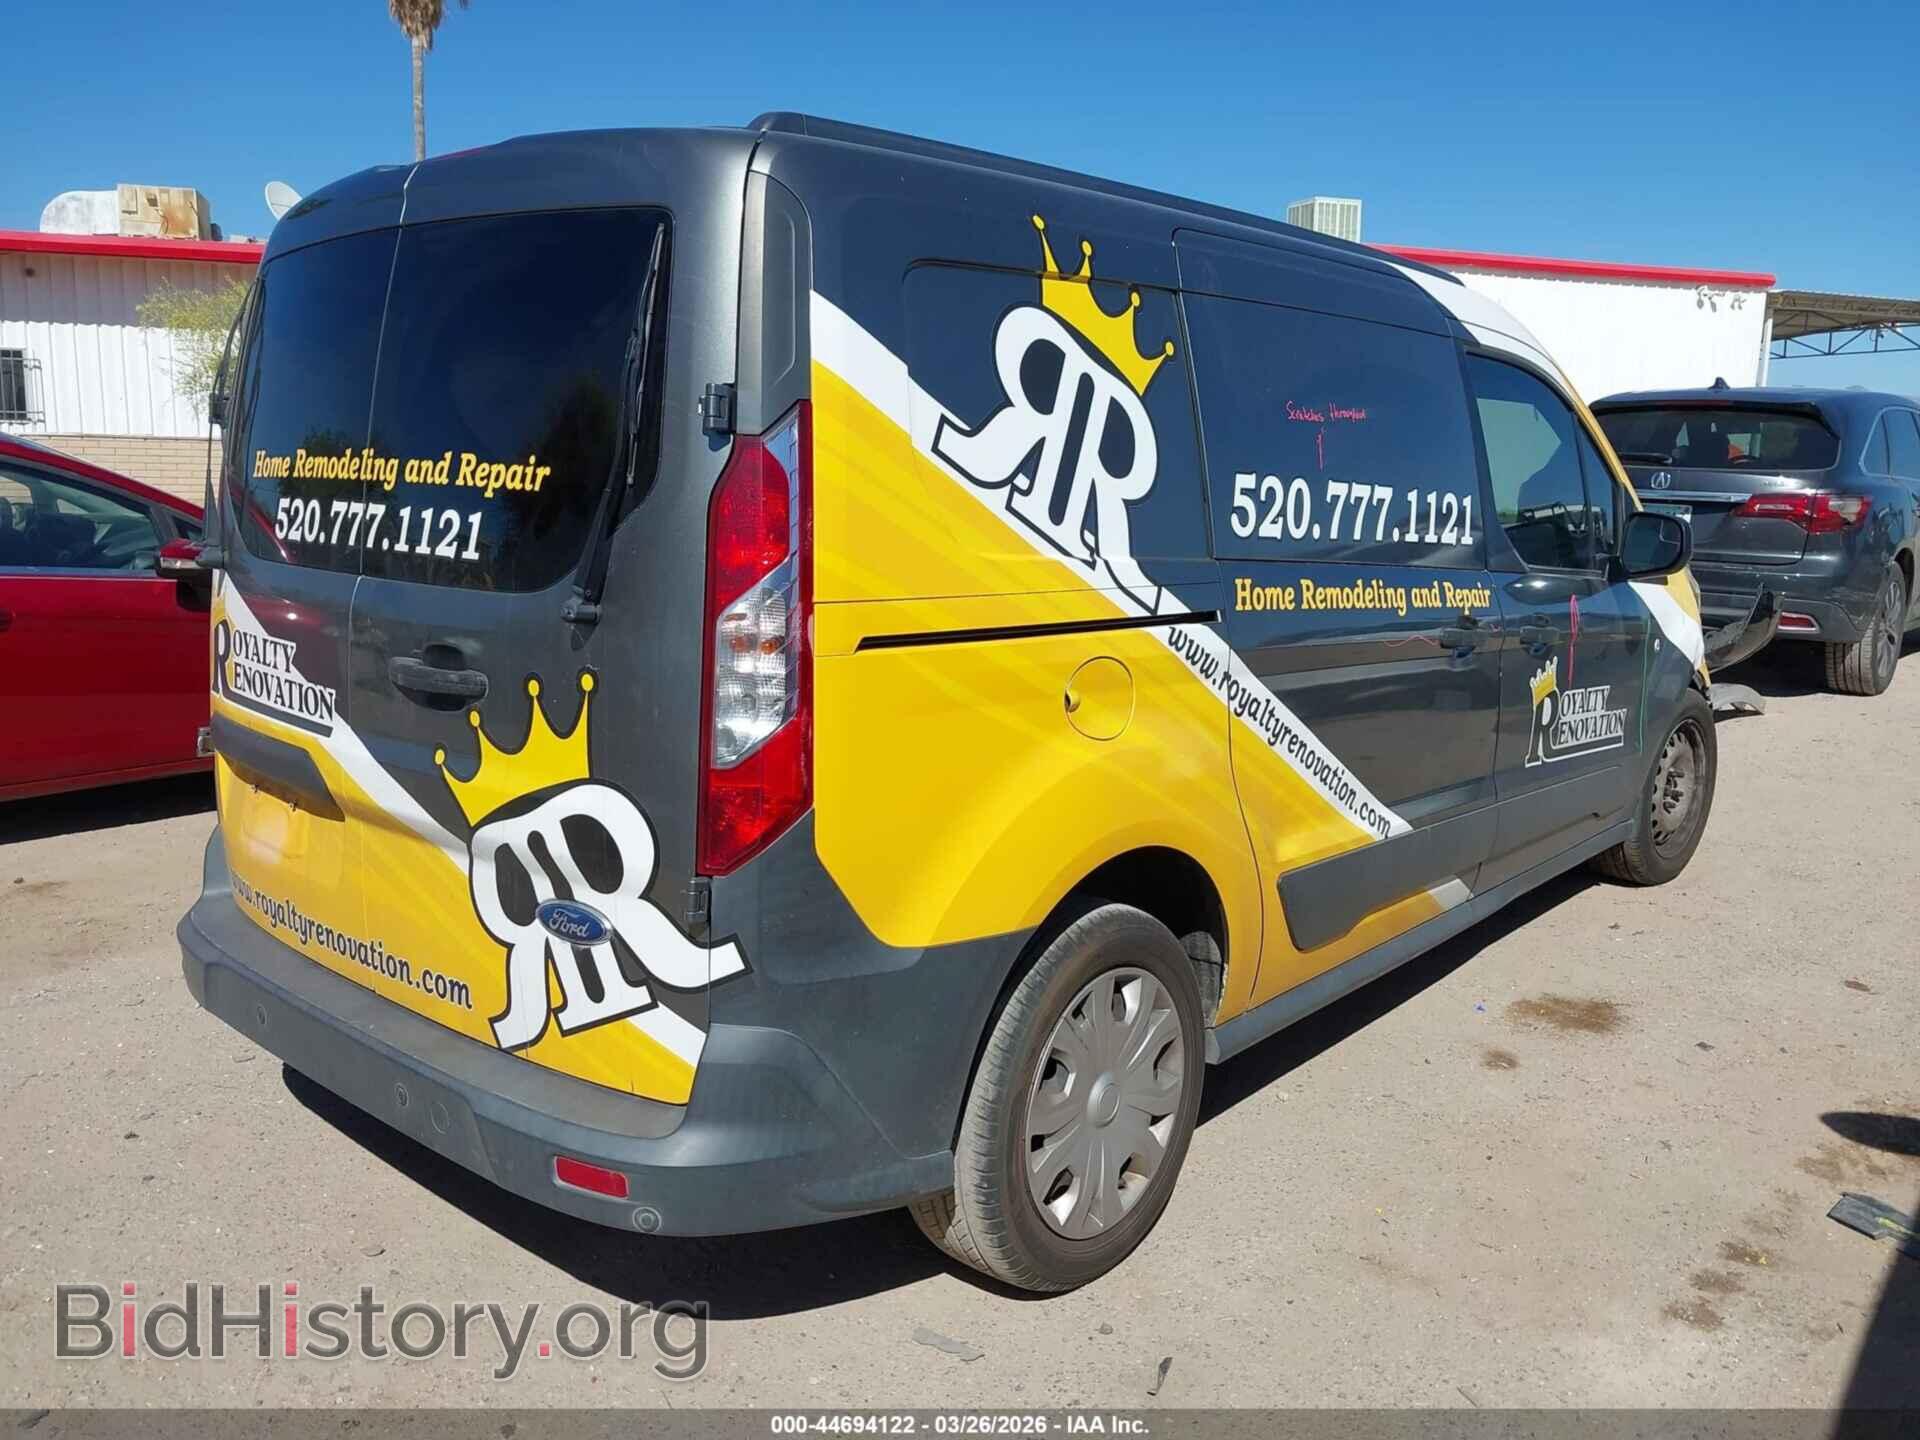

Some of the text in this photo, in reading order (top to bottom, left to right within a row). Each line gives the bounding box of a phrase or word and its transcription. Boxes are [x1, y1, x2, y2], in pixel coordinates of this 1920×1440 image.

[252, 448, 551, 498] Home Remodeling and Repair
[274, 497, 483, 561] 520.777.1121
[1230, 472, 1474, 546] 520.777.1121
[1233, 577, 1491, 616] Home Remodeling and Repair
[1168, 626, 1392, 838] www.royaltyrenovation.com
[548, 908, 591, 937] Ford
